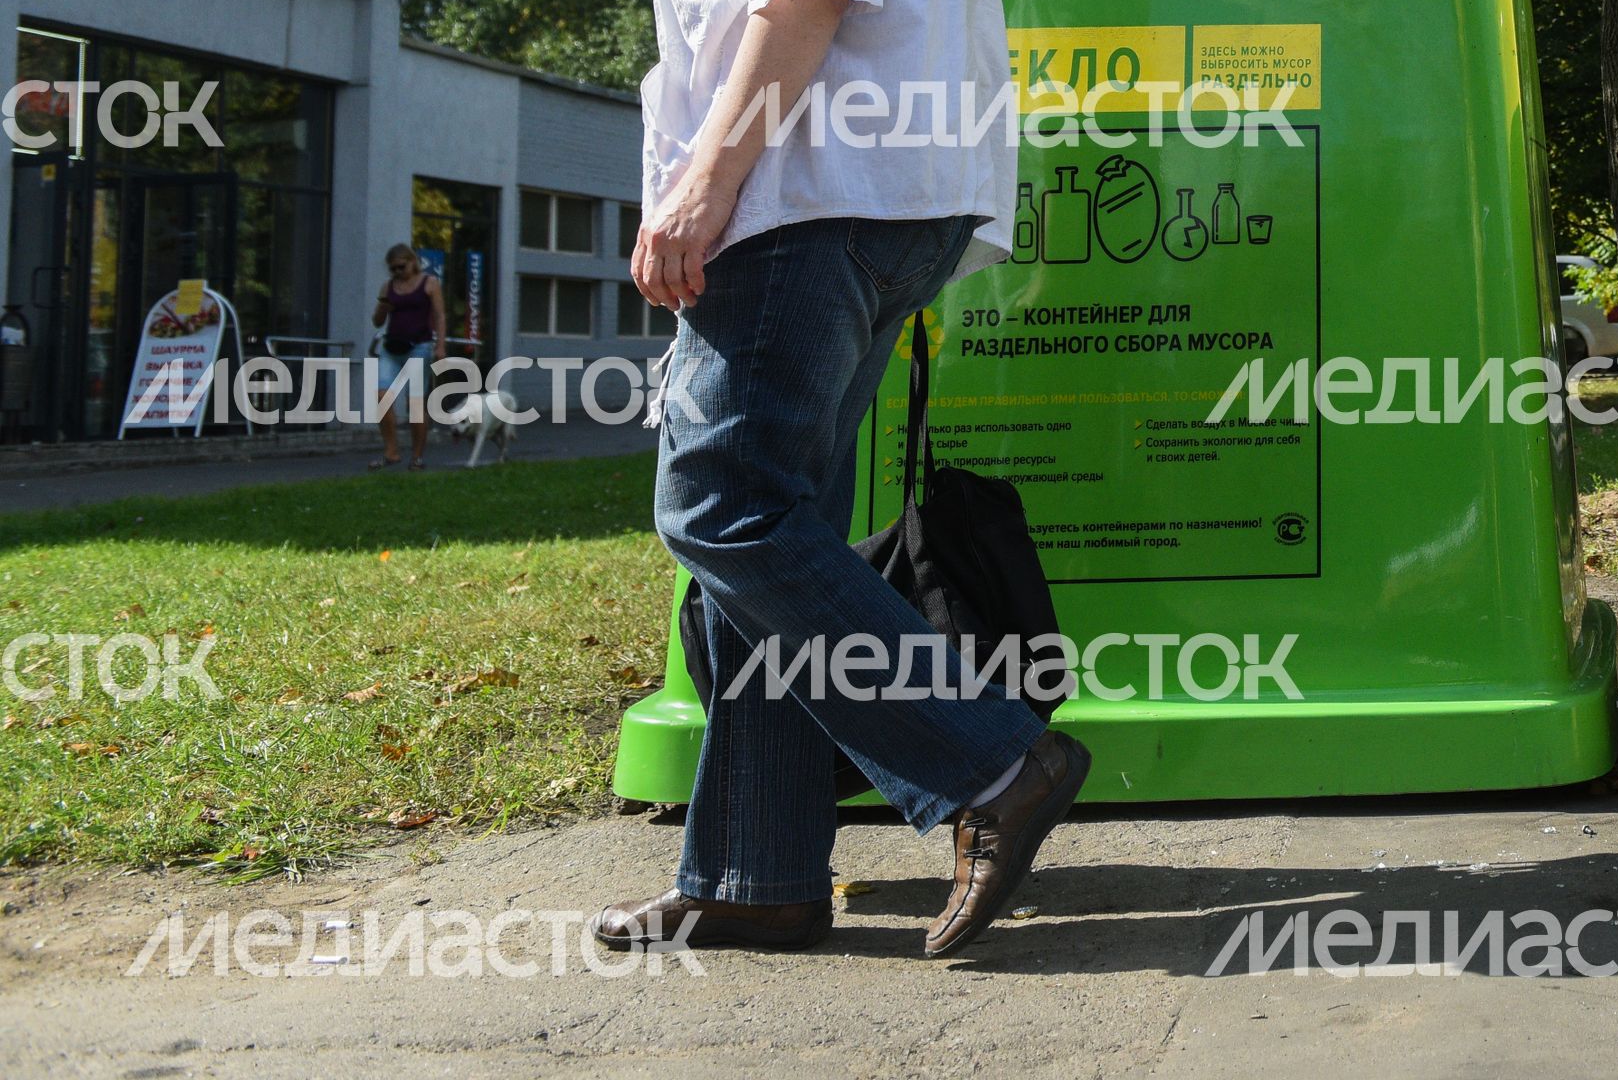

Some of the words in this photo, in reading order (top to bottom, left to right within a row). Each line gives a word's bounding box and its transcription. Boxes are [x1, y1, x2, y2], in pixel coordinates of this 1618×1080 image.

[1201, 46, 1236, 57] ЗДЕСЬ
[1241, 46, 1284, 56] МОЖНО
[1201, 60, 1268, 69] ВЫБРОСИТЬ
[1273, 59, 1311, 68] МУСОР
[1201, 73, 1312, 91] РАЗДЕЛЬНО
[961, 308, 1000, 328] ЭТО
[1023, 303, 1144, 326] КОНТЕЙНЕР
[1148, 304, 1191, 327] ДЛЯ
[961, 334, 1109, 359] РАЗДЕЛЬНОГО
[1115, 333, 1183, 354] СБОРА
[1188, 331, 1274, 353] МУСОРА
[887, 397, 908, 408] ЕСЛ
[940, 396, 977, 409] БУДЕМ
[980, 395, 1048, 406] ПРАВИЛЬНО
[1050, 394, 1076, 404] ИМИ
[1173, 392, 1187, 401] ТО
[954, 423, 971, 434] раз
[975, 422, 1043, 433] использовать
[1047, 421, 1071, 432] одно
[1146, 419, 1188, 431] Сделать
[1191, 418, 1226, 430] воздух
[1229, 419, 1235, 427] в
[1238, 417, 1276, 428] Москве
[1280, 417, 1310, 428] чище,
[898, 440, 903, 449] и
[937, 439, 968, 450] сырье
[1146, 437, 1199, 449] Сохранить
[1202, 435, 1252, 447] экологию
[1255, 435, 1273, 446] для
[1277, 434, 1301, 445] себя
[953, 456, 1010, 467] природные
[1013, 455, 1056, 466] ресурсы
[1147, 454, 1152, 462] и
[1156, 453, 1185, 462] своих
[1188, 452, 1220, 463] детей.
[1071, 472, 1104, 483] среды
[1083, 522, 1166, 533] контейнерами
[1169, 520, 1183, 531] по
[1186, 517, 1262, 529] назначению!
[1057, 539, 1080, 549] наш
[1084, 537, 1140, 548] любимый
[1144, 537, 1181, 549] город.
